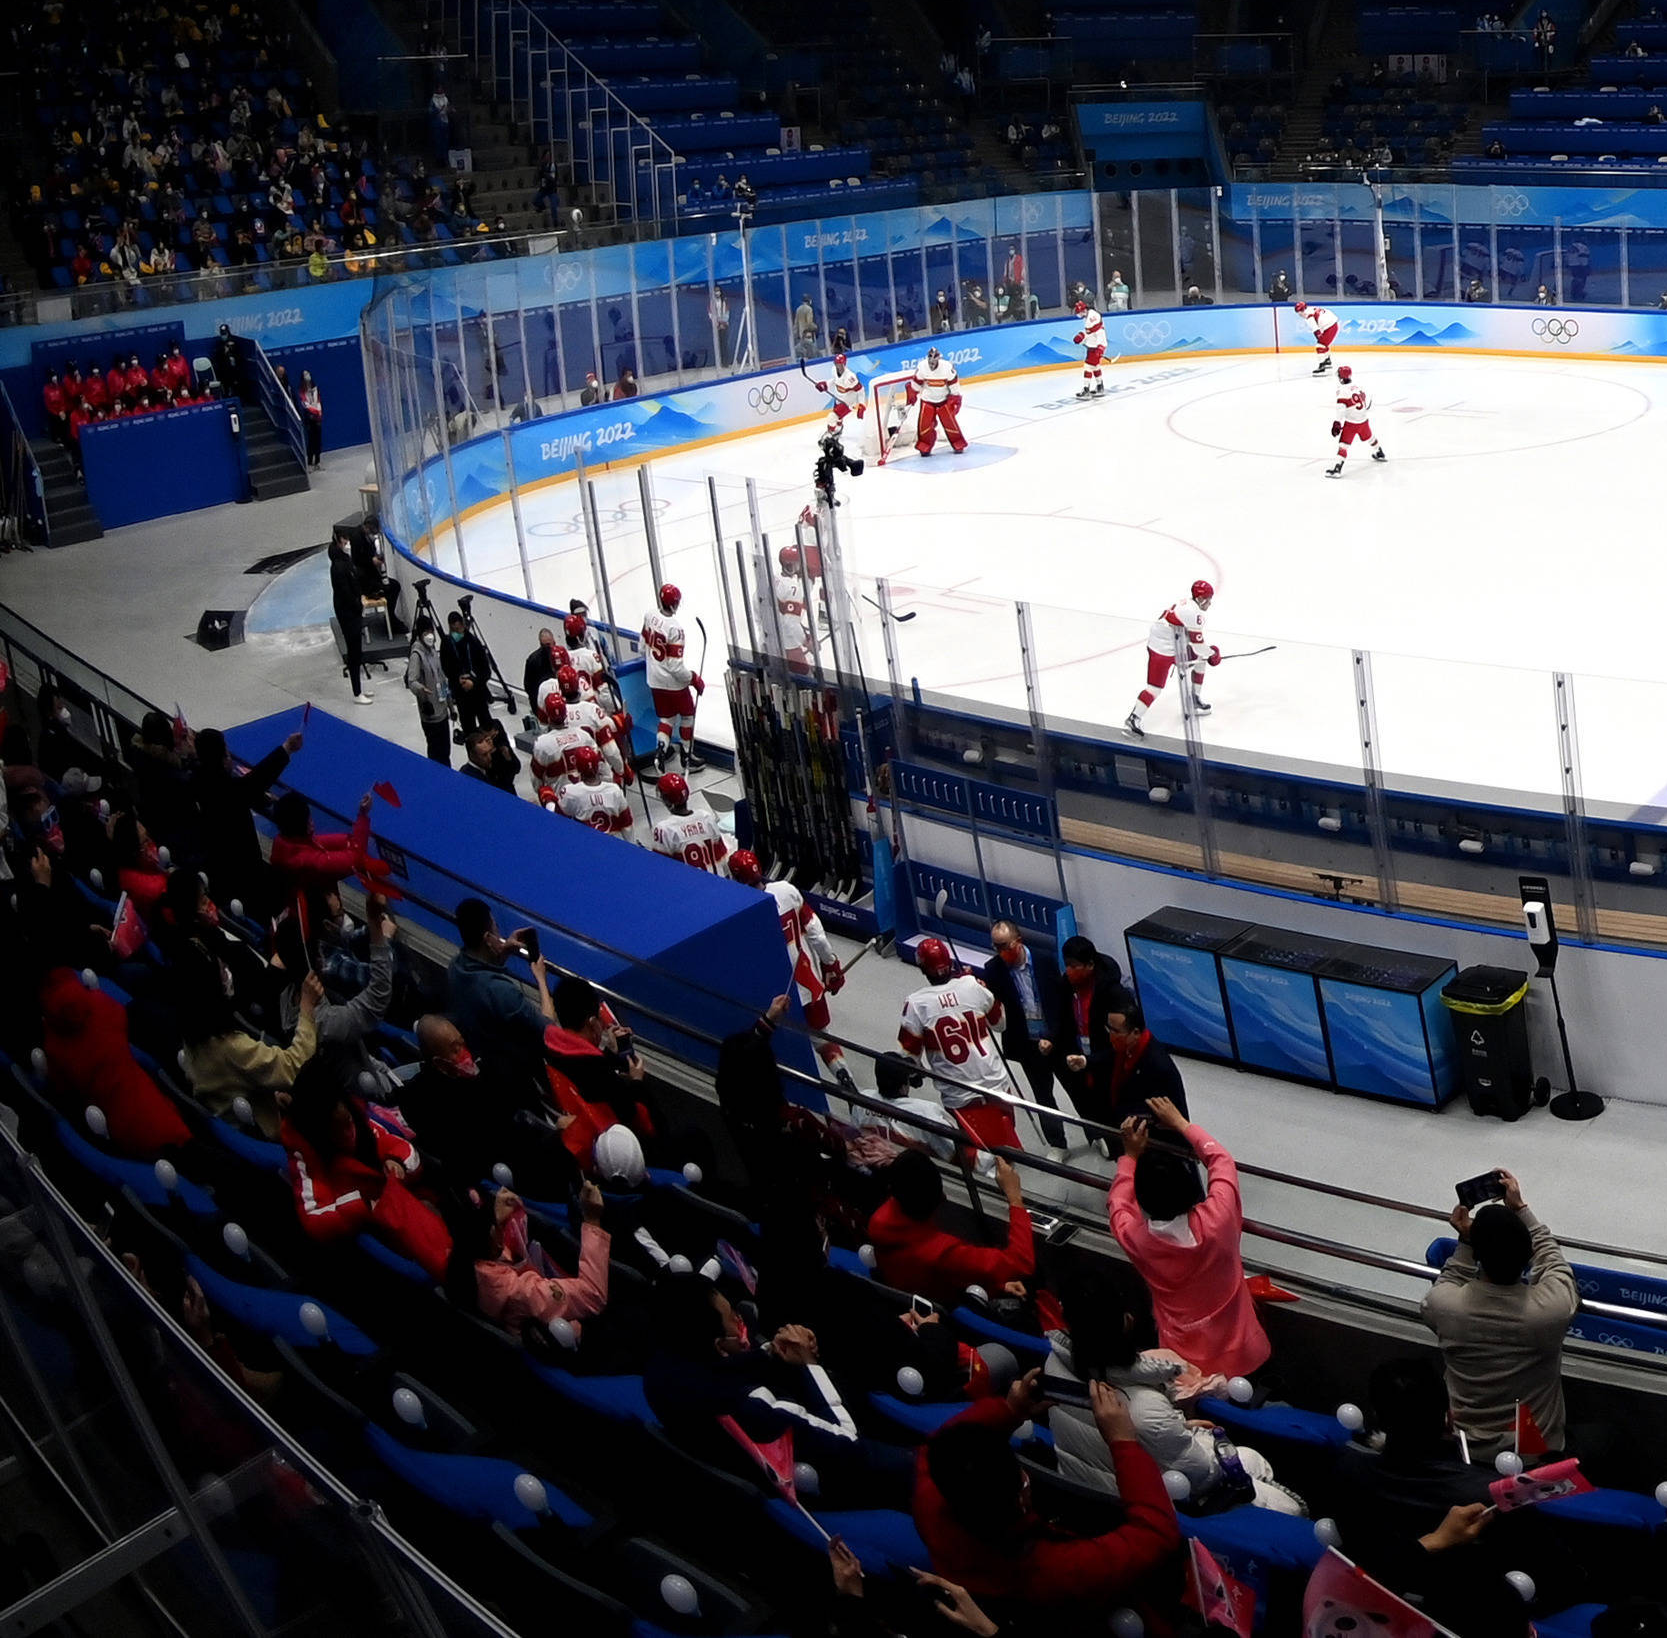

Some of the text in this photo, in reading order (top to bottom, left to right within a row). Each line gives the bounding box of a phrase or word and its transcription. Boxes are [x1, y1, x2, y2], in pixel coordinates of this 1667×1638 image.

[1104, 111, 1179, 126] BEIJING 2022
[266, 307, 306, 325] 2022
[1356, 318, 1400, 333] 2022
[948, 346, 983, 365] 2022
[540, 422, 638, 462] BEIJING 2022
[938, 992, 959, 1008] WEI
[933, 1008, 988, 1066] 61
